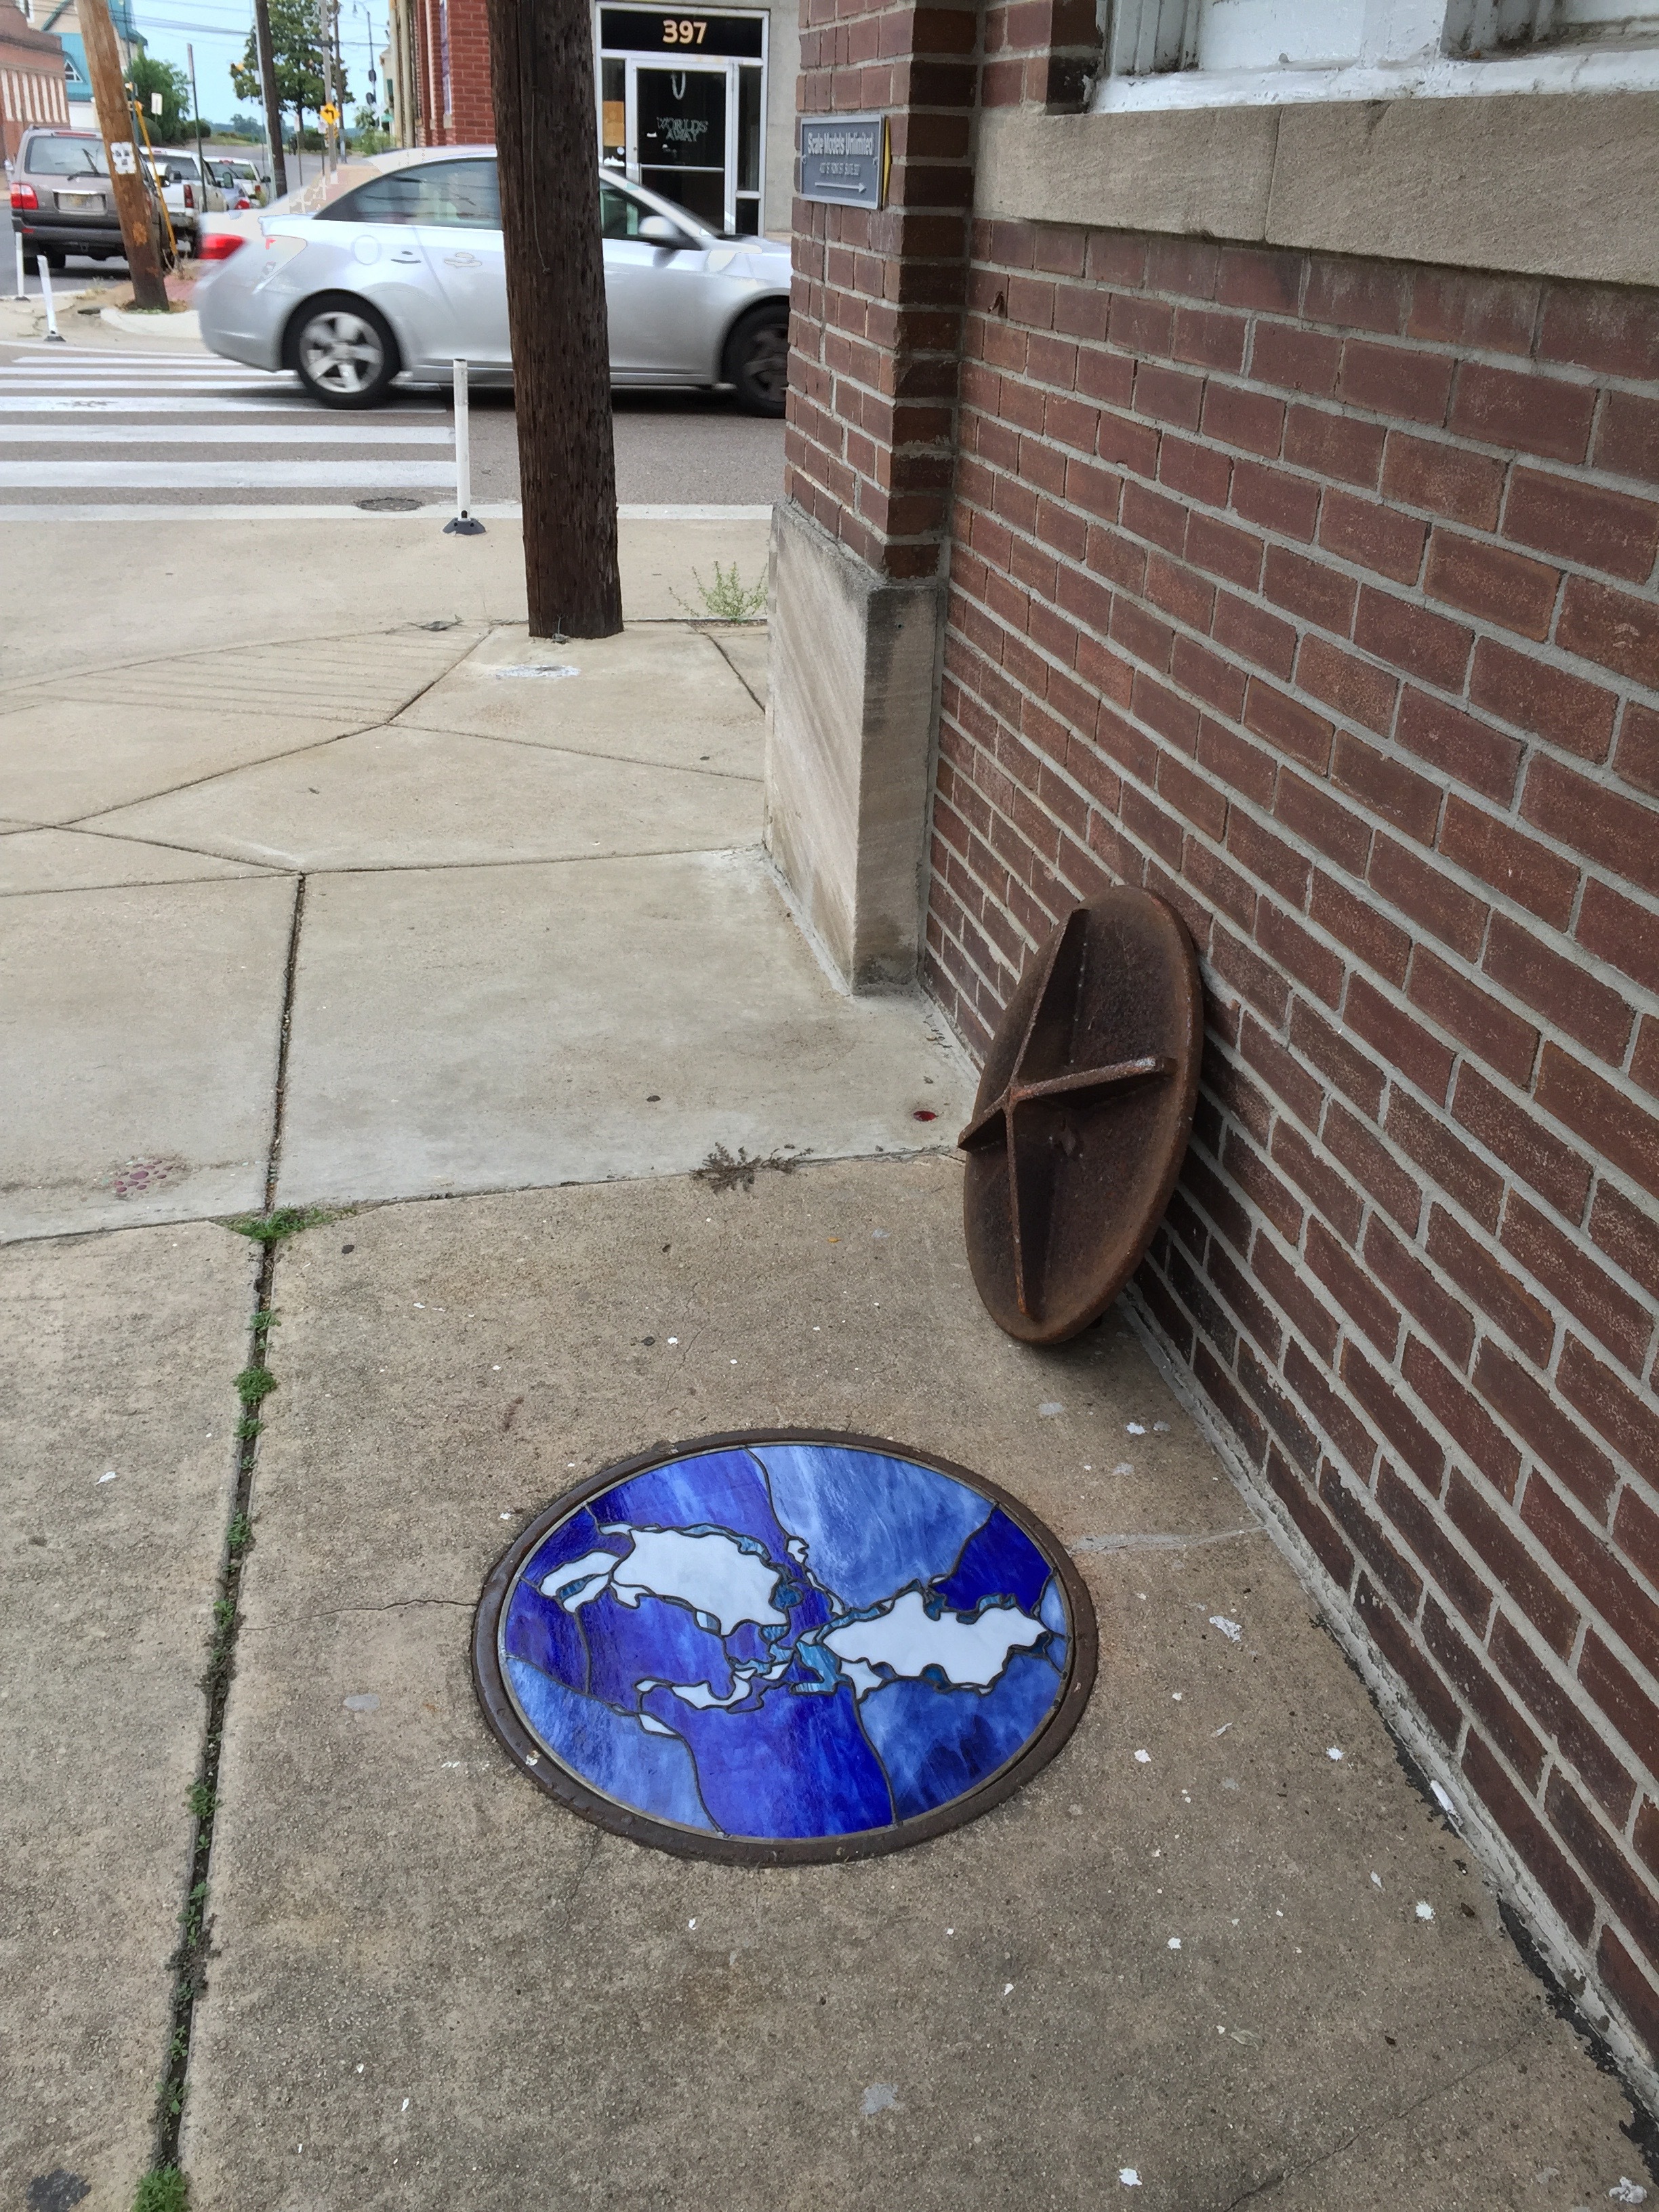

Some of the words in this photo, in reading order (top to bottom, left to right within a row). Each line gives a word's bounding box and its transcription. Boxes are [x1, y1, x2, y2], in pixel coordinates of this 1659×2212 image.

[662, 19, 708, 45] 397
[666, 129, 701, 142] AWAY
[808, 131, 824, 155] Scale
[824, 131, 845, 155] Models
[846, 131, 874, 156] Unlimited
